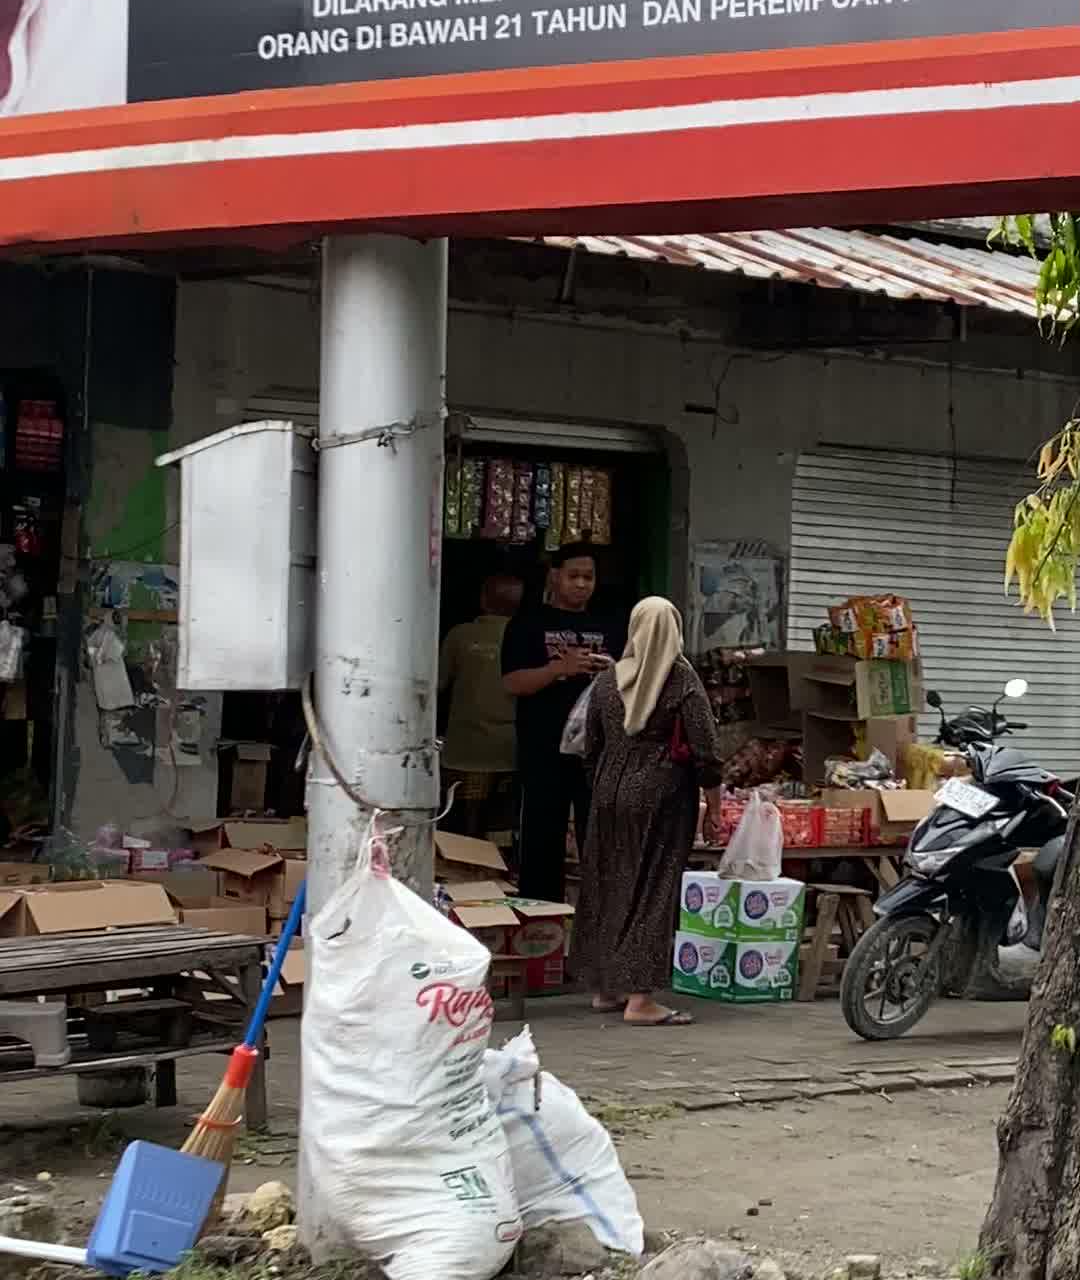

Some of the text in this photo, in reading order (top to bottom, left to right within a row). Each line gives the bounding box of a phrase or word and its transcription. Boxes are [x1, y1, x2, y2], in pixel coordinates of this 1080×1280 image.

[257, 27, 350, 61] ORANG
[355, 24, 383, 51] DI
[389, 15, 488, 48] BAWAH
[493, 12, 522, 40] 21
[530, 3, 627, 36] TAHUN
